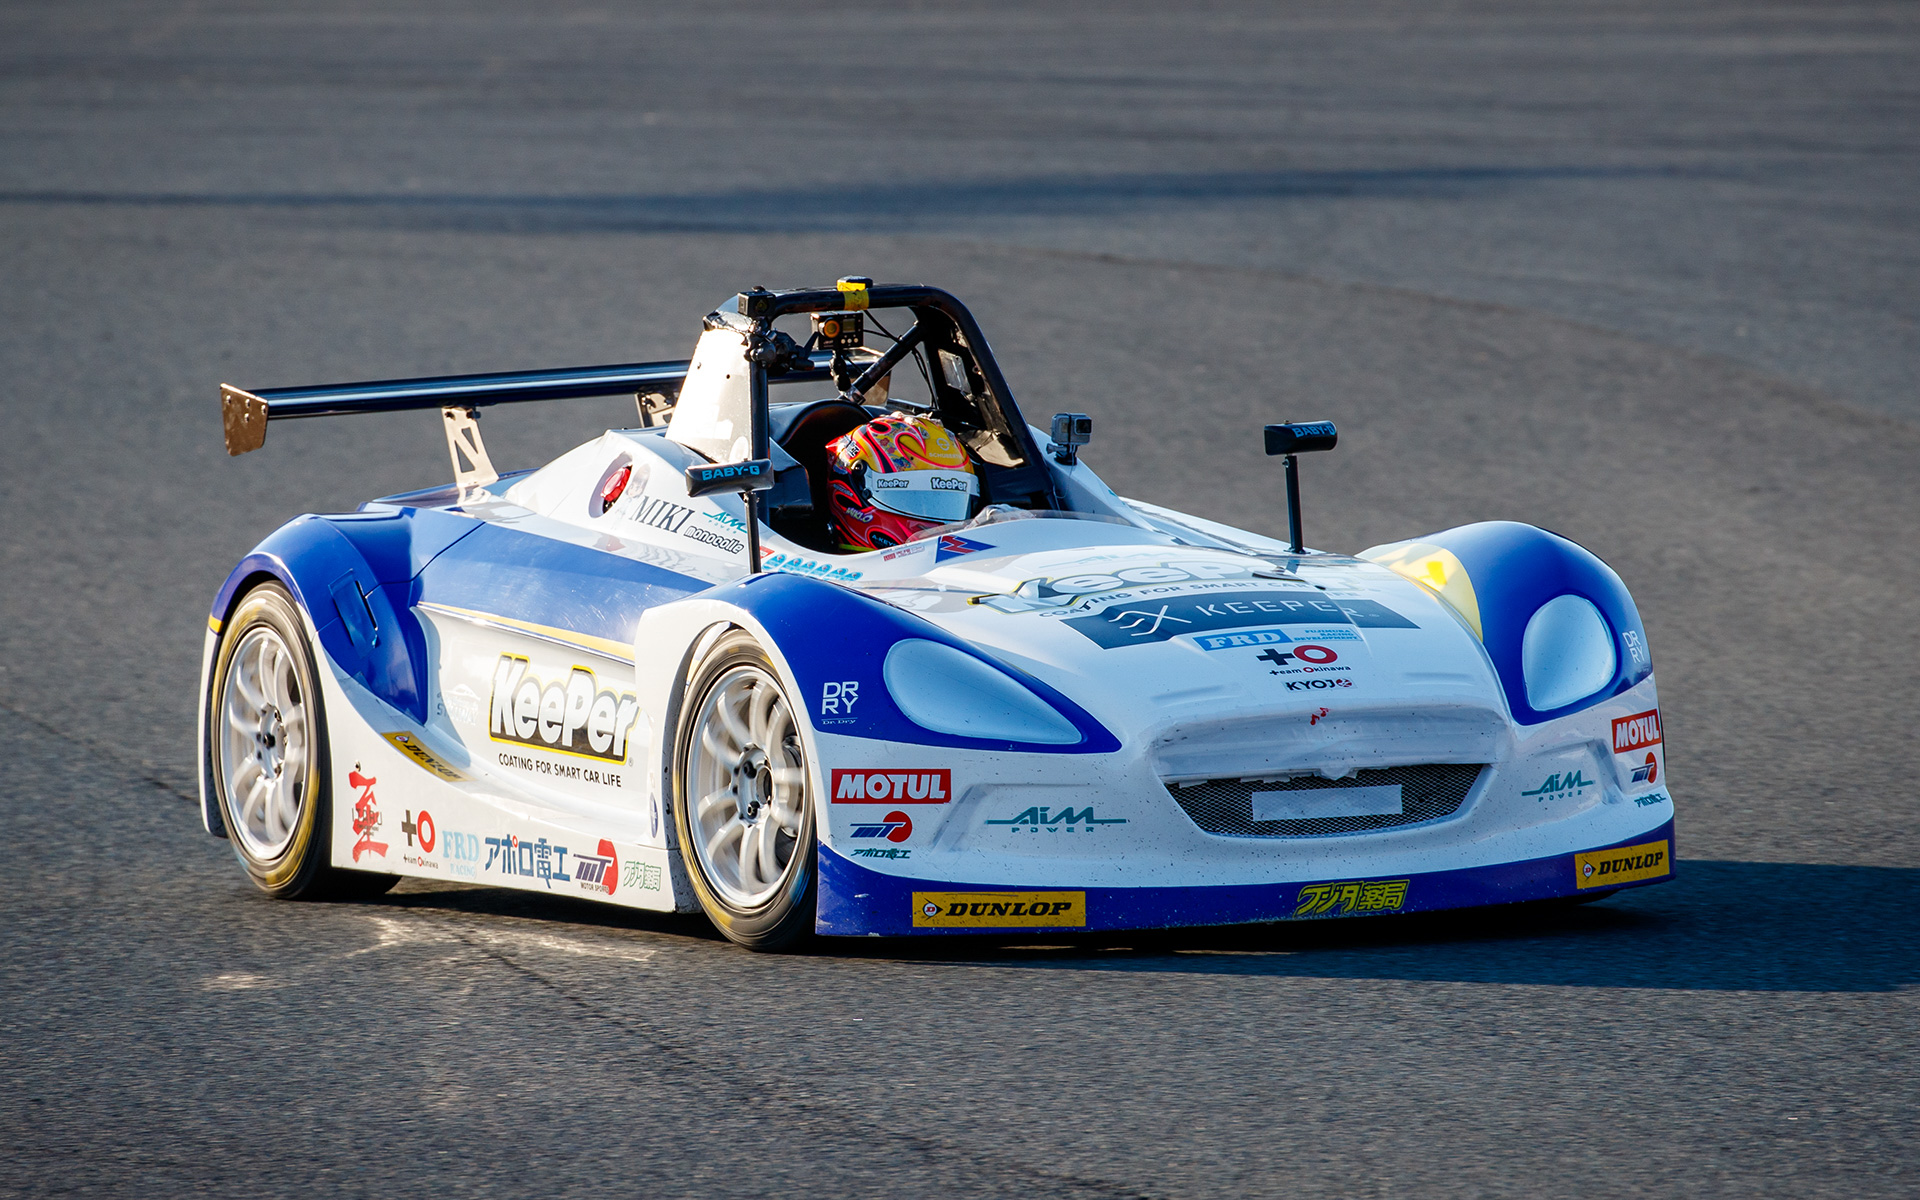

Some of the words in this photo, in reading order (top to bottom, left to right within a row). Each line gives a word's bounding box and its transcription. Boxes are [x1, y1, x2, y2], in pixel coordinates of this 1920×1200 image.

[702, 465, 760, 481] BABY-G
[877, 479, 909, 489] KeePer
[931, 477, 967, 491] KeePer
[629, 496, 695, 533] MIKI
[683, 525, 744, 555] monocolle
[1038, 592, 1133, 618] COATING
[1139, 586, 1183, 596] FOR
[1190, 582, 1259, 590] SMART
[1196, 600, 1364, 618] KEEPER
[1204, 632, 1282, 649] FRD
[1303, 666, 1352, 674] Okinawa
[490, 654, 641, 757] KeePer
[1615, 715, 1660, 749] MOTUL
[498, 752, 533, 771] COATING
[536, 760, 552, 775] FOR
[554, 763, 581, 780] SMART
[583, 769, 600, 784] CAR
[602, 773, 622, 788] LIFE
[836, 774, 946, 800] MOTUL
[442, 830, 480, 862] FRD
[485, 834, 571, 889] アポロ電工
[1598, 851, 1663, 875] DUNLOP
[945, 902, 1072, 917] DUNLOP
